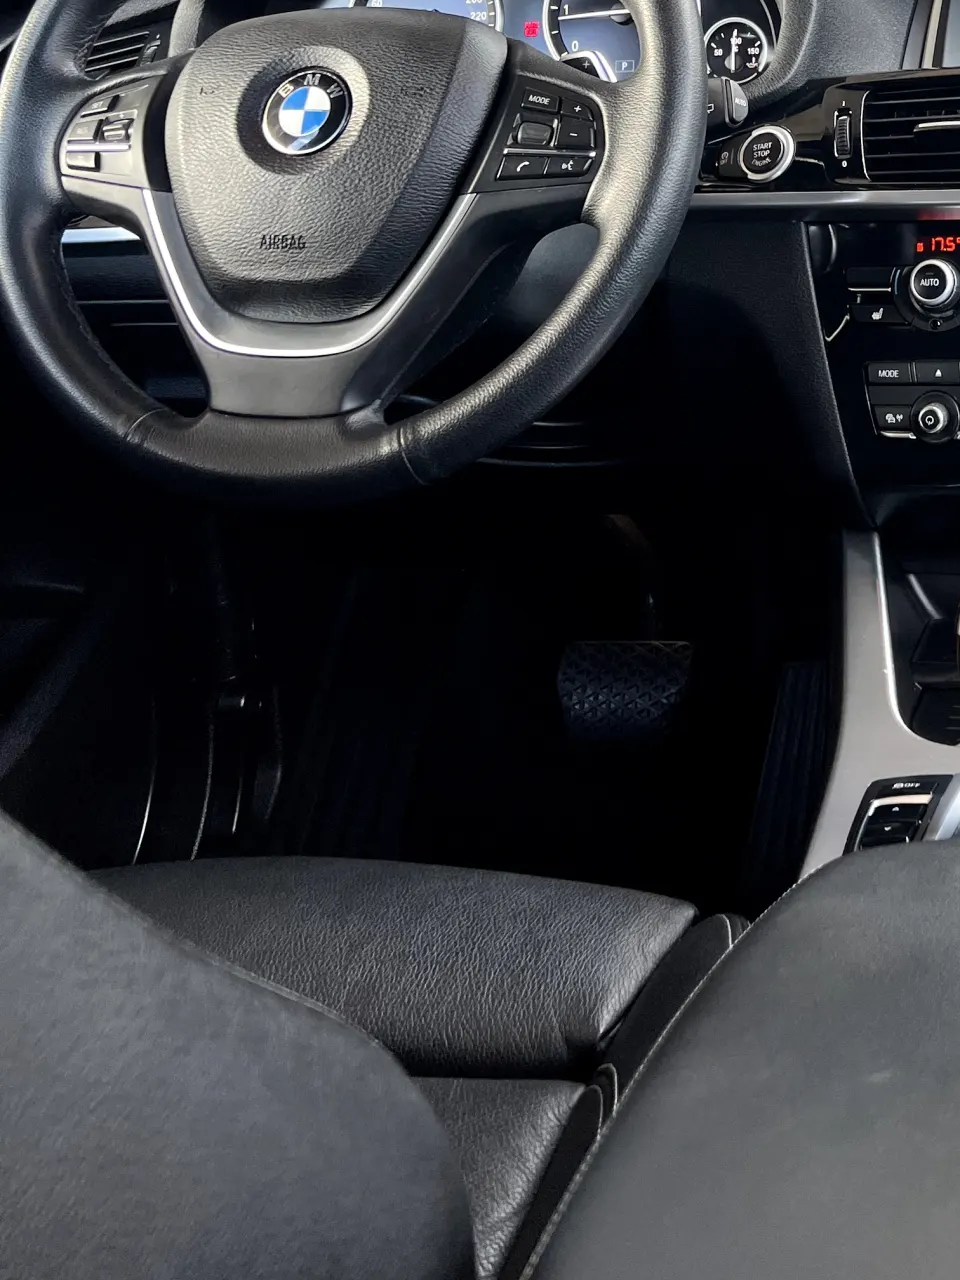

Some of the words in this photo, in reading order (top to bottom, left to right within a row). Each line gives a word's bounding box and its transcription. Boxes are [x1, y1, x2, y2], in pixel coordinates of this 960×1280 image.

[371, 0, 383, 8] 60
[563, 4, 569, 16] 1
[470, 11, 487, 21] 220
[571, 40, 579, 51] 0
[713, 48, 723, 57] 50
[747, 47, 760, 55] 150
[278, 73, 344, 99] BMW
[528, 94, 551, 106] MODE
[734, 96, 747, 108] AUTO
[752, 141, 773, 151] START
[753, 149, 771, 158] STOP
[751, 157, 772, 167] ENGINE
[259, 233, 307, 251] AIRBAG
[919, 278, 940, 286] AUTO
[878, 369, 900, 378] MODE
